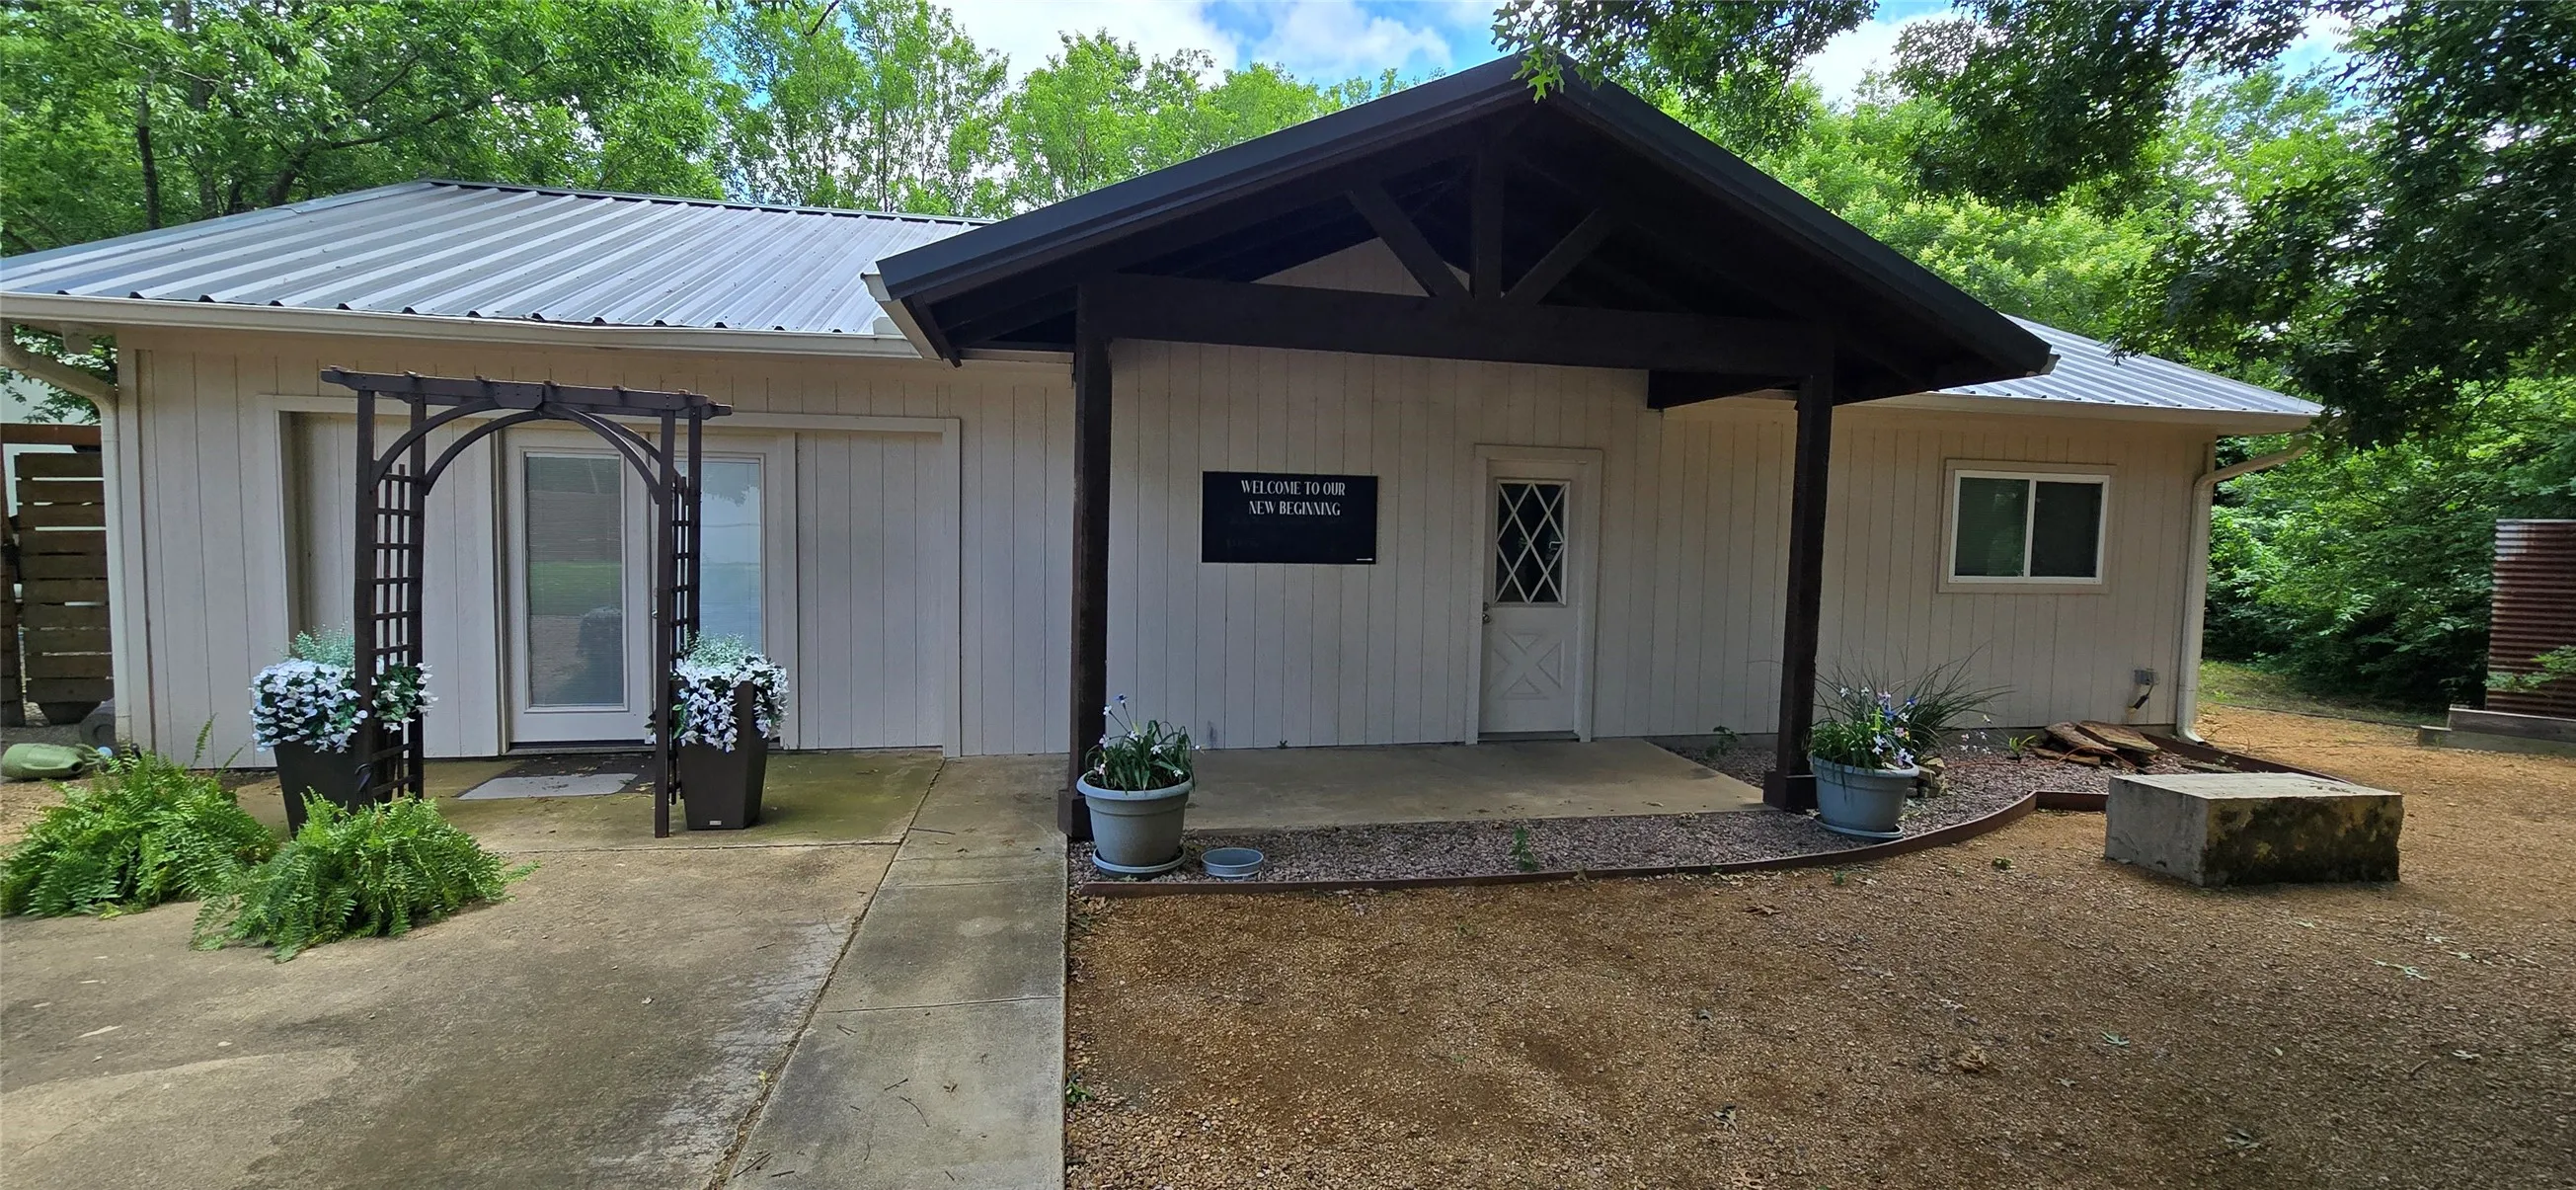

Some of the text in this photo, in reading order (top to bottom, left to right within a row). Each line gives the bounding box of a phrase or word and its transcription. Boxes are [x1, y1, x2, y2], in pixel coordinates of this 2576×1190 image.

[1241, 480, 1346, 496] WELCOME TO OUR
[1249, 501, 1341, 516] NEW BEGINNING
